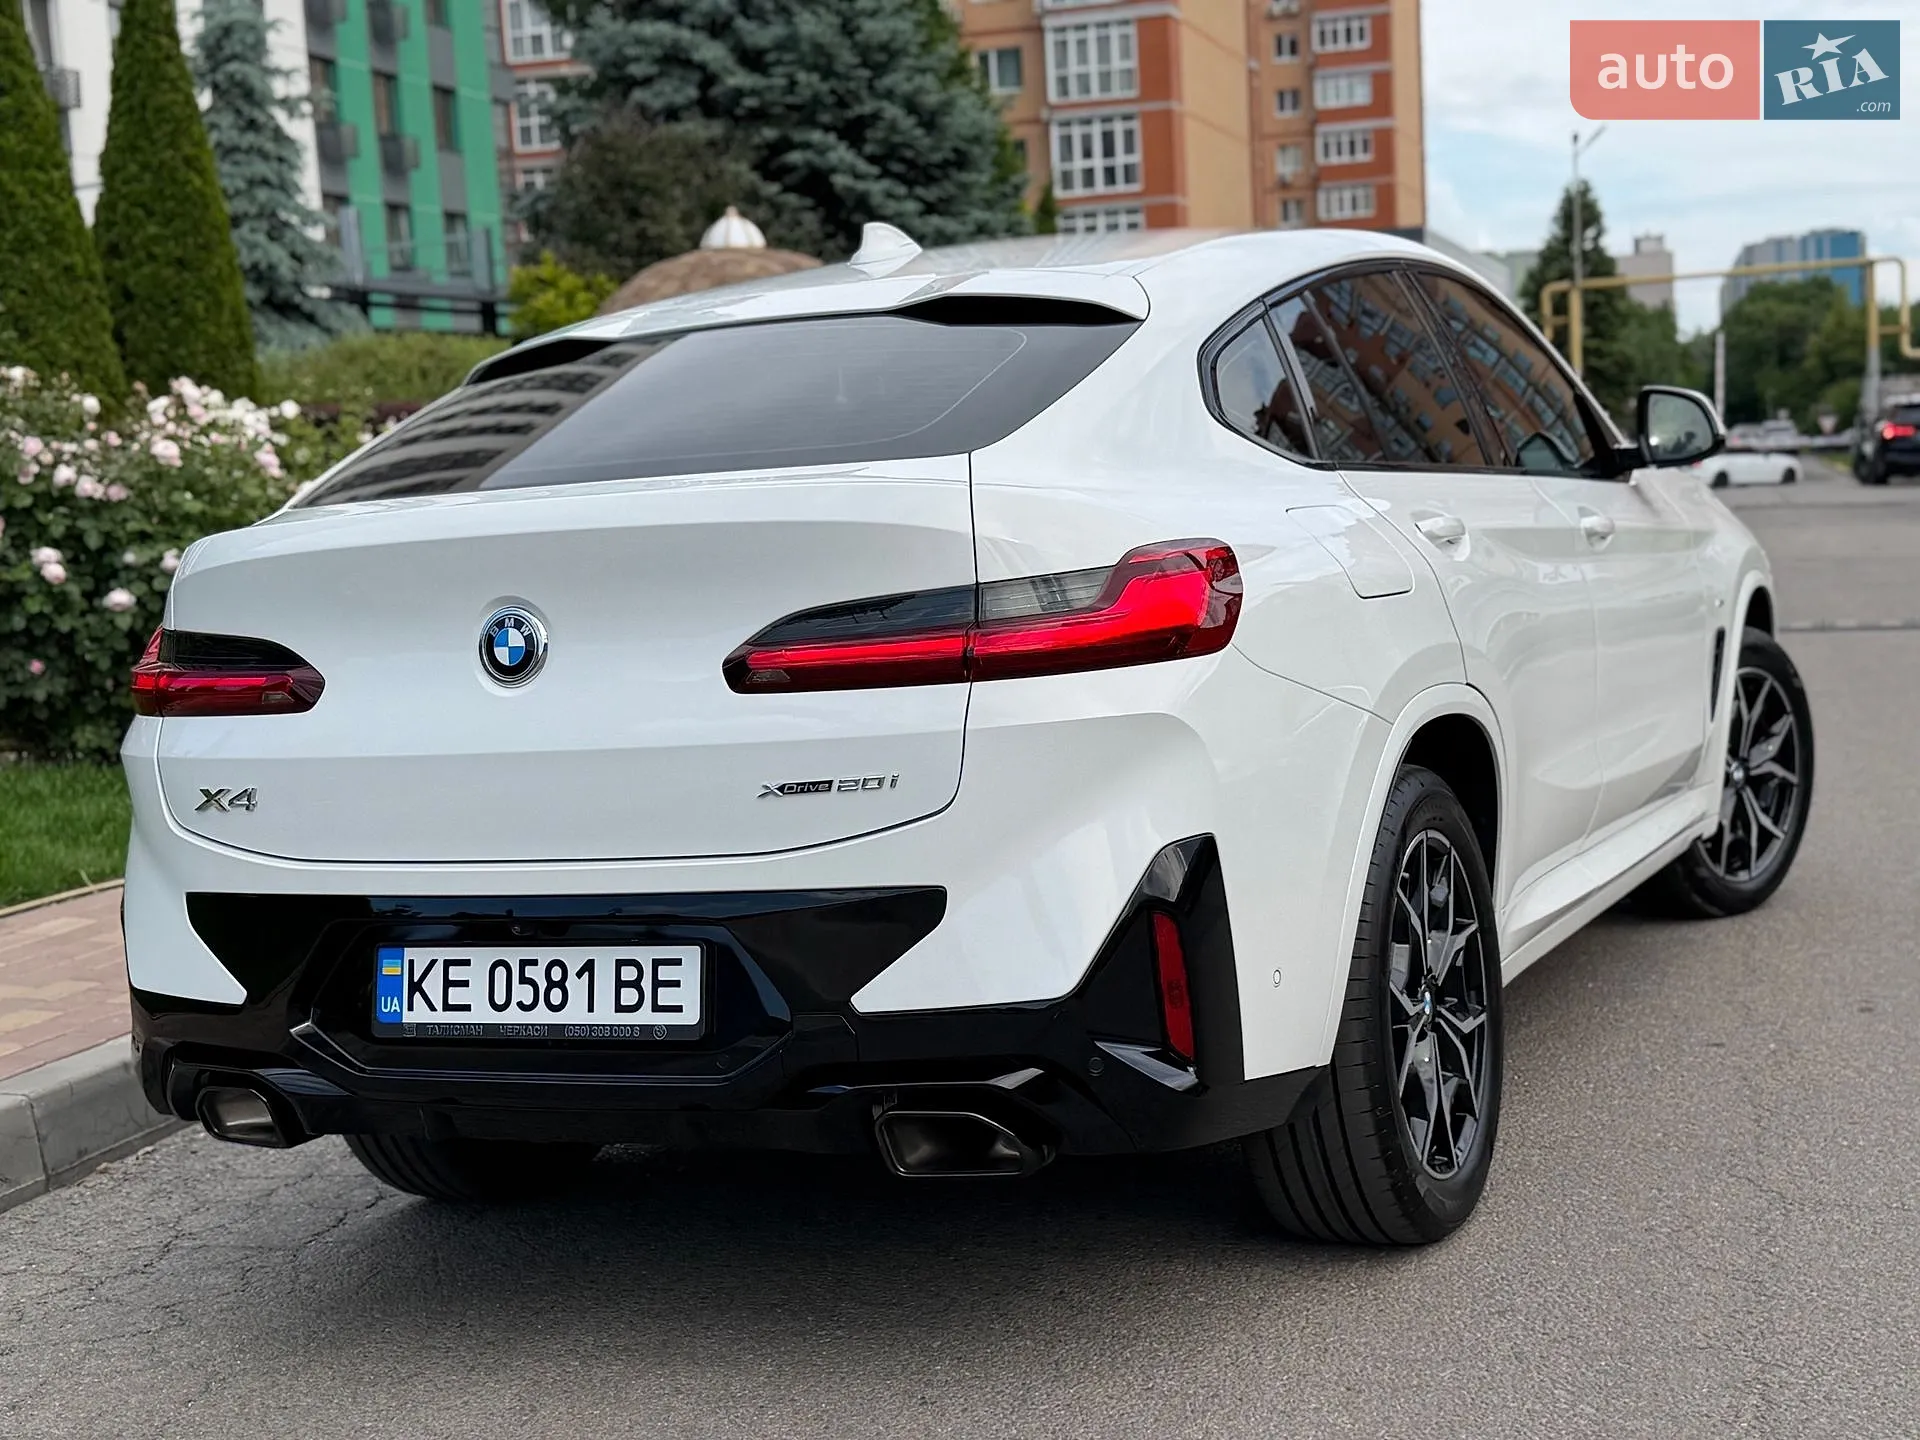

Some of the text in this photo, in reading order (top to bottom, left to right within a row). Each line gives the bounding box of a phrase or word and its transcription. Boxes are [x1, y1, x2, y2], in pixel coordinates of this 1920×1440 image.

[489, 617, 532, 638] BMW
[194, 787, 258, 812] X4
[407, 957, 684, 1013] KE 0581 BE
[381, 996, 400, 1013] UA
[427, 1025, 483, 1036] ТАЛИСМАН
[499, 1025, 548, 1037] ЧЕРКАСИ
[564, 1025, 590, 1037] (050)
